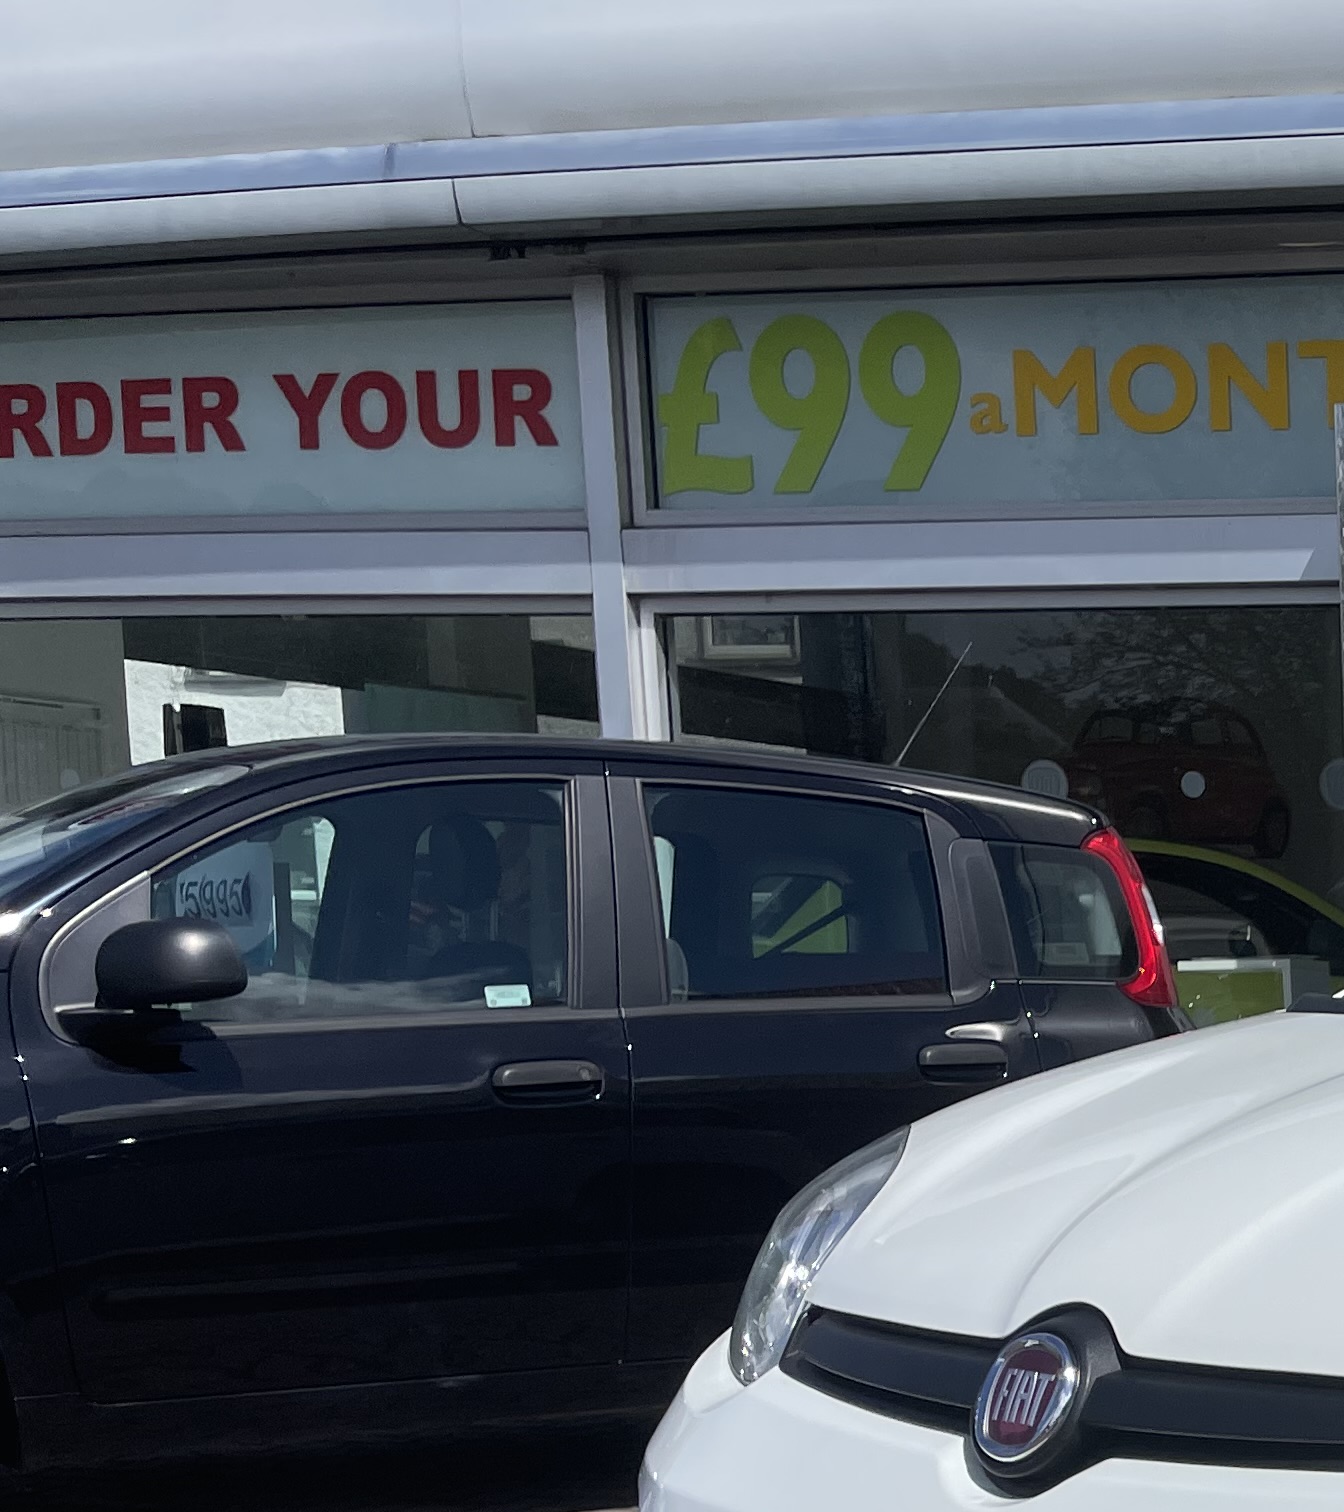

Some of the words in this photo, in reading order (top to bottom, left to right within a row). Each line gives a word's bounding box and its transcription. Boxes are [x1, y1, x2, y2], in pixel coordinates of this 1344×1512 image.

[272, 369, 560, 451] YOUR
[659, 309, 962, 496] £99
[991, 1367, 1057, 1428] FIAT
